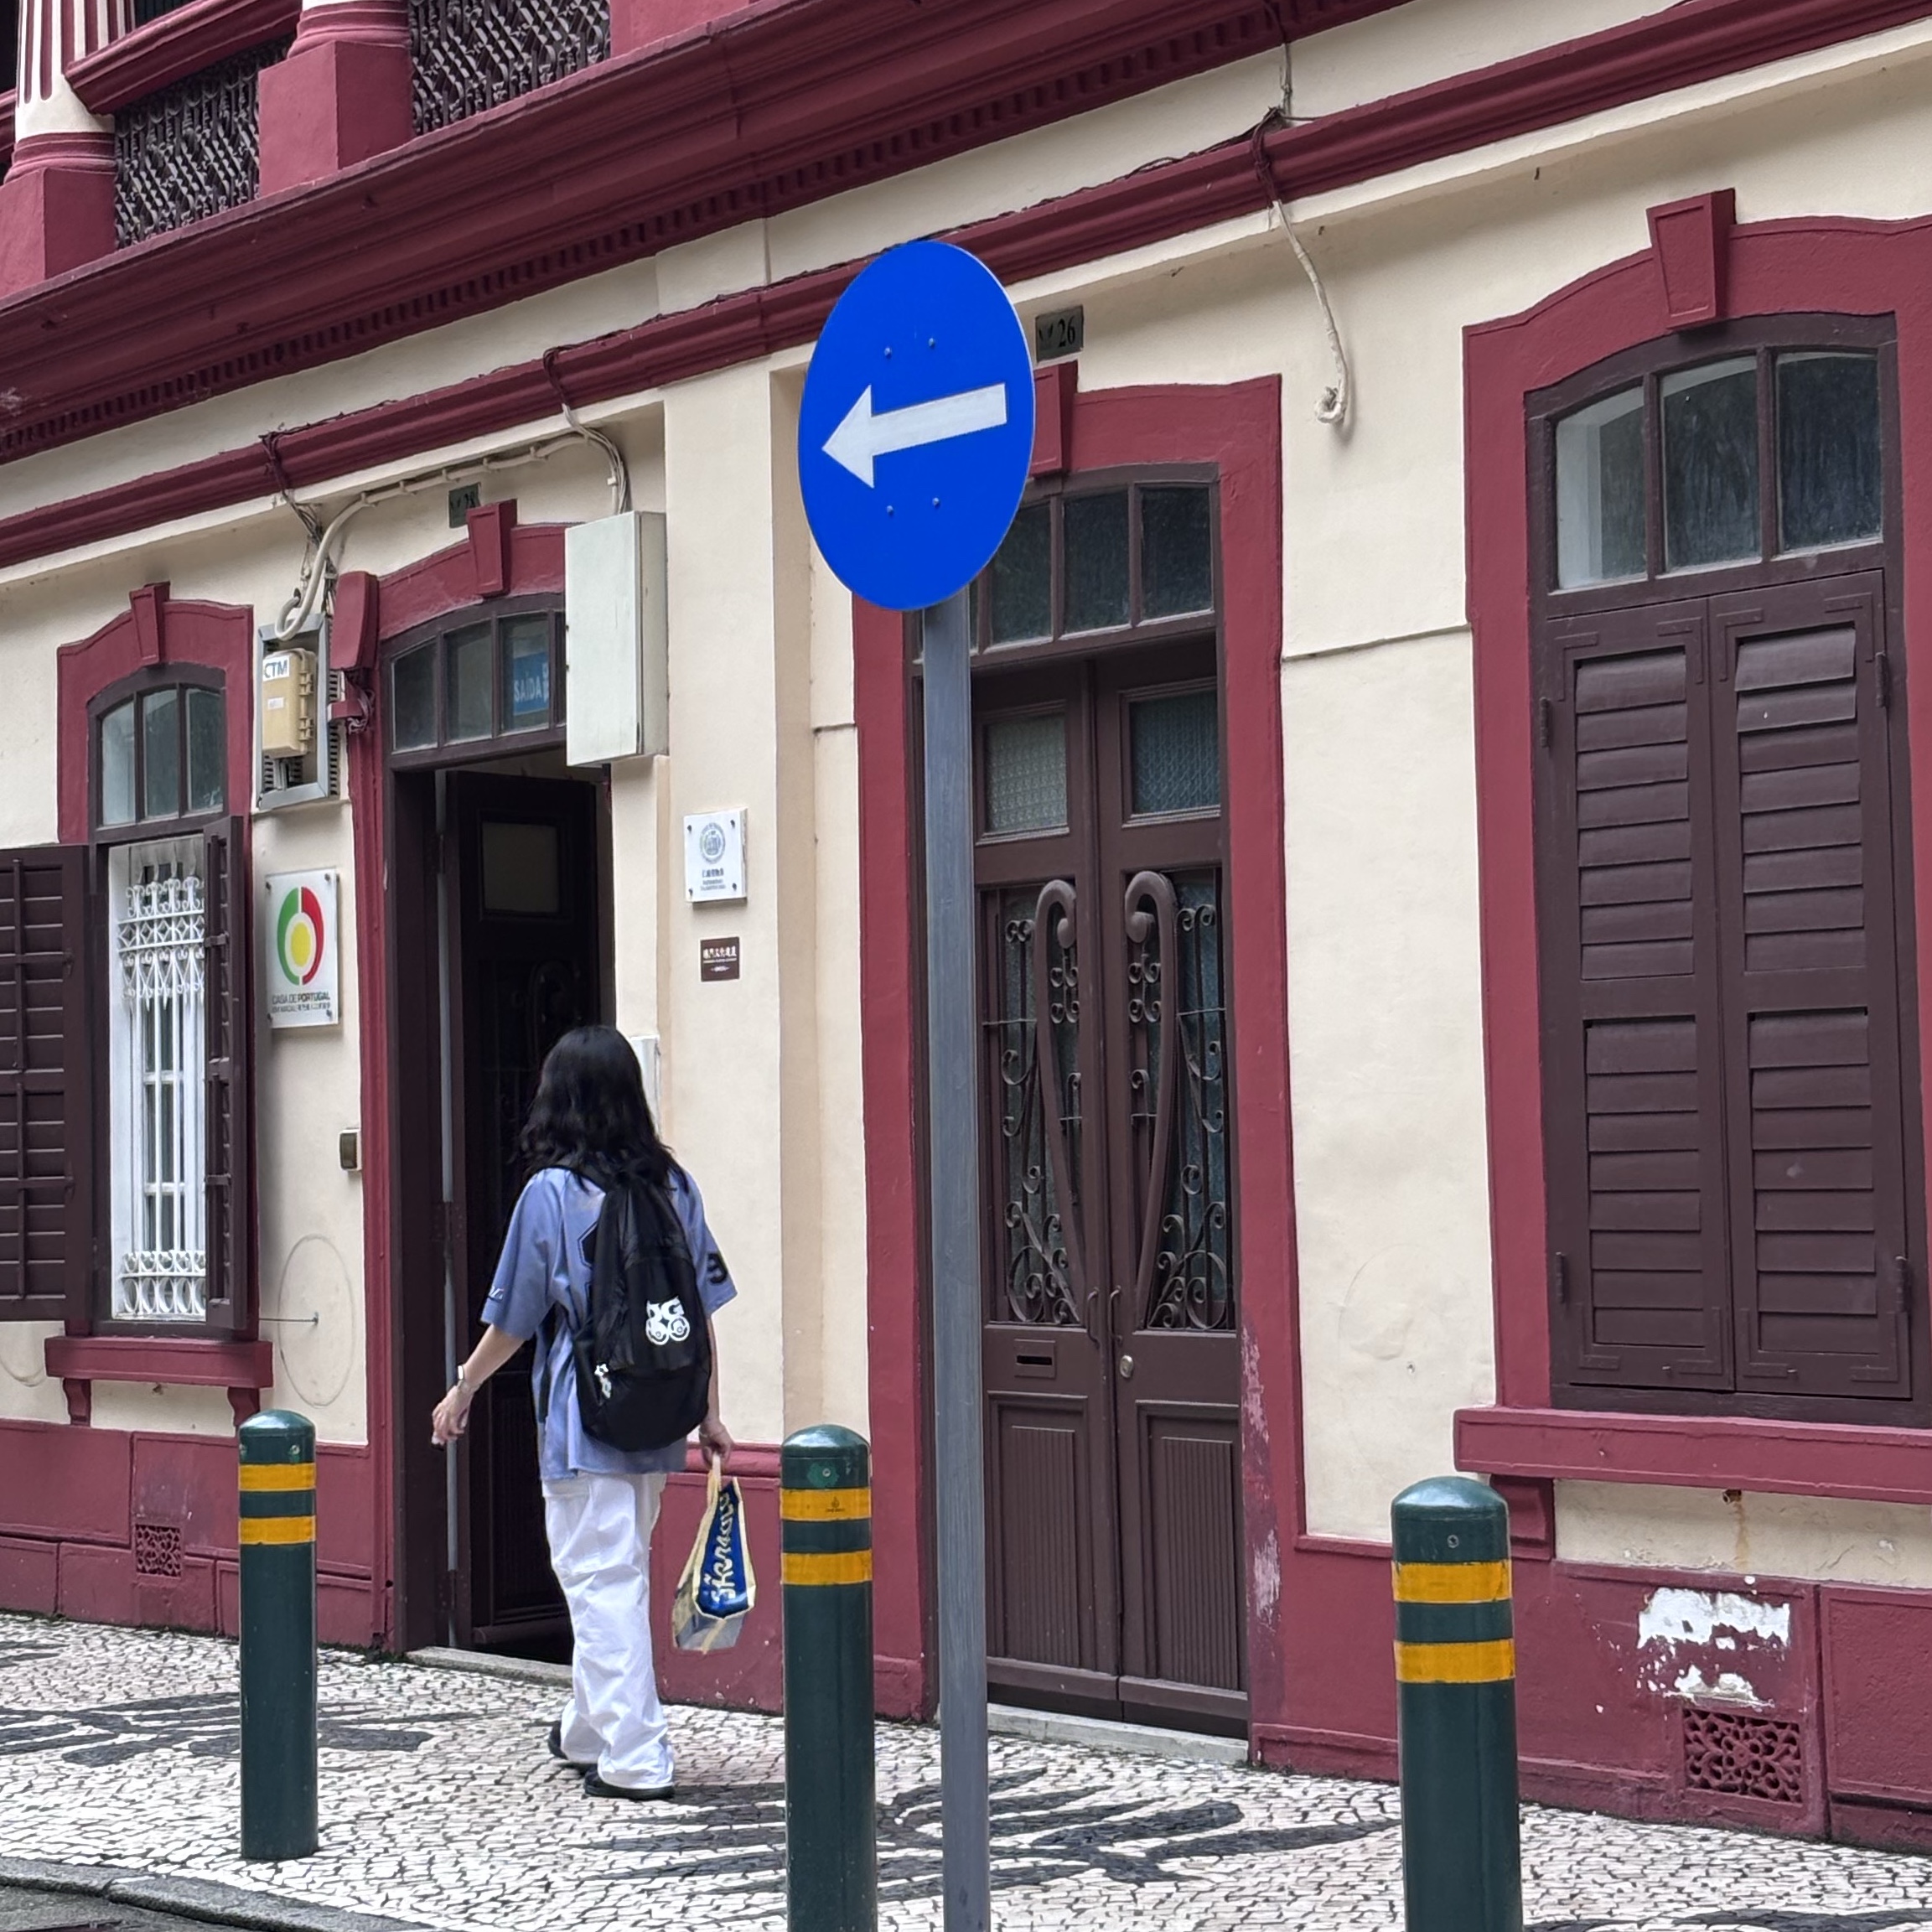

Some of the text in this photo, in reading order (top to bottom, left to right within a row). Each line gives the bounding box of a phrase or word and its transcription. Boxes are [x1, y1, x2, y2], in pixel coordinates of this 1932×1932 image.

[1057, 315, 1075, 348] 26
[264, 660, 287, 679] CTM
[298, 990, 330, 1003] PORTUGAL
